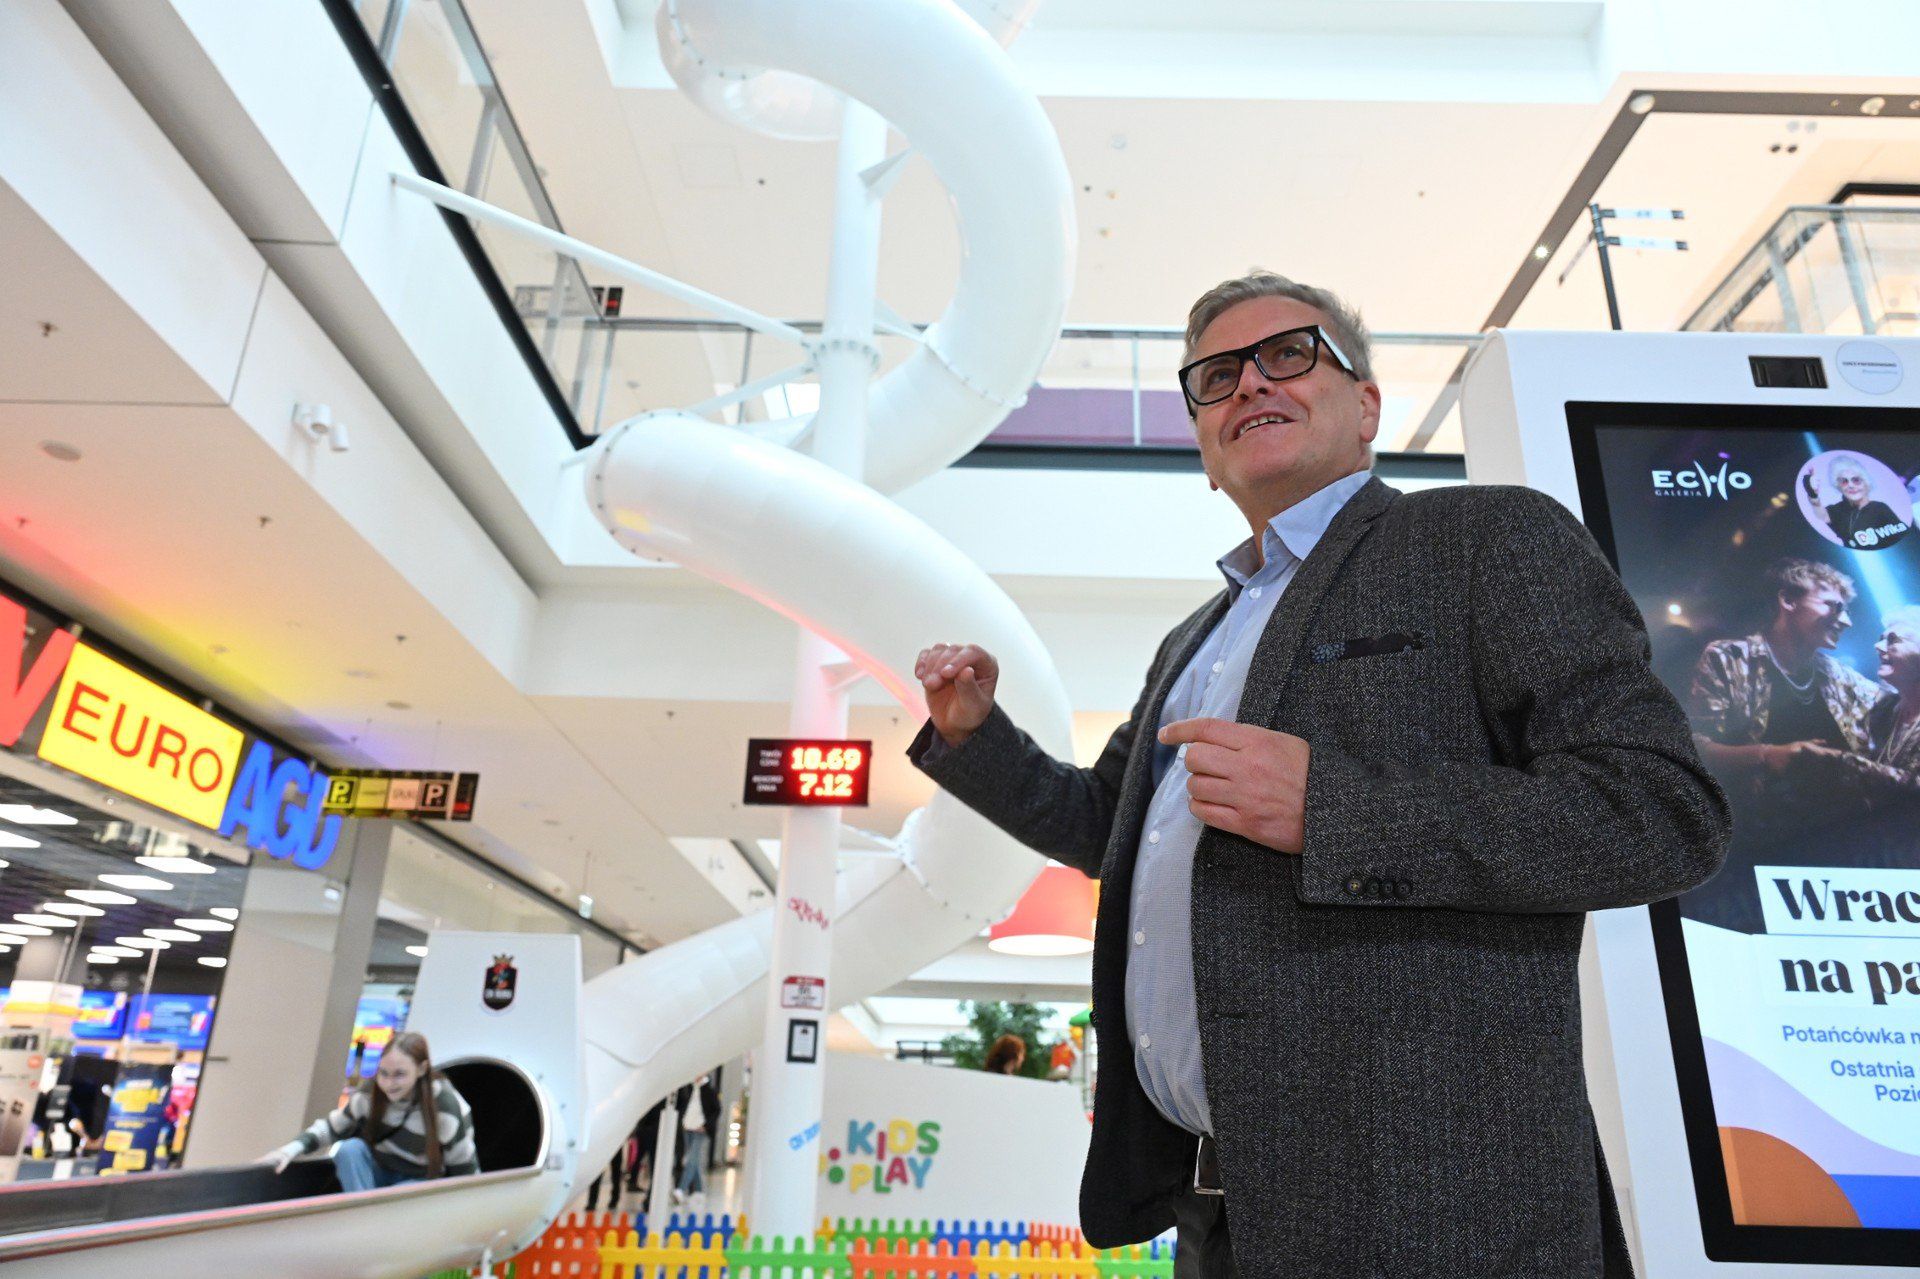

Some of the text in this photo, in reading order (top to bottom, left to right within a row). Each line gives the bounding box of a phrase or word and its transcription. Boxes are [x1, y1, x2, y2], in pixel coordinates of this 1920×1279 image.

[1651, 459, 1753, 501] ECHO
[1654, 488, 1703, 498] GALERIA
[1875, 522, 1908, 539] Wika
[61, 680, 223, 793] EURO
[790, 746, 862, 771] 10.69
[799, 772, 853, 797] 7.12
[1772, 878, 1920, 924] Wrac
[1779, 959, 1854, 993] na
[1782, 1025, 1905, 1044] Potańcówka
[1830, 1060, 1915, 1078] Ostatnia
[1875, 1084, 1920, 1102] Pozi
[848, 1119, 941, 1161] KIDS
[849, 1156, 933, 1194] PLAY
